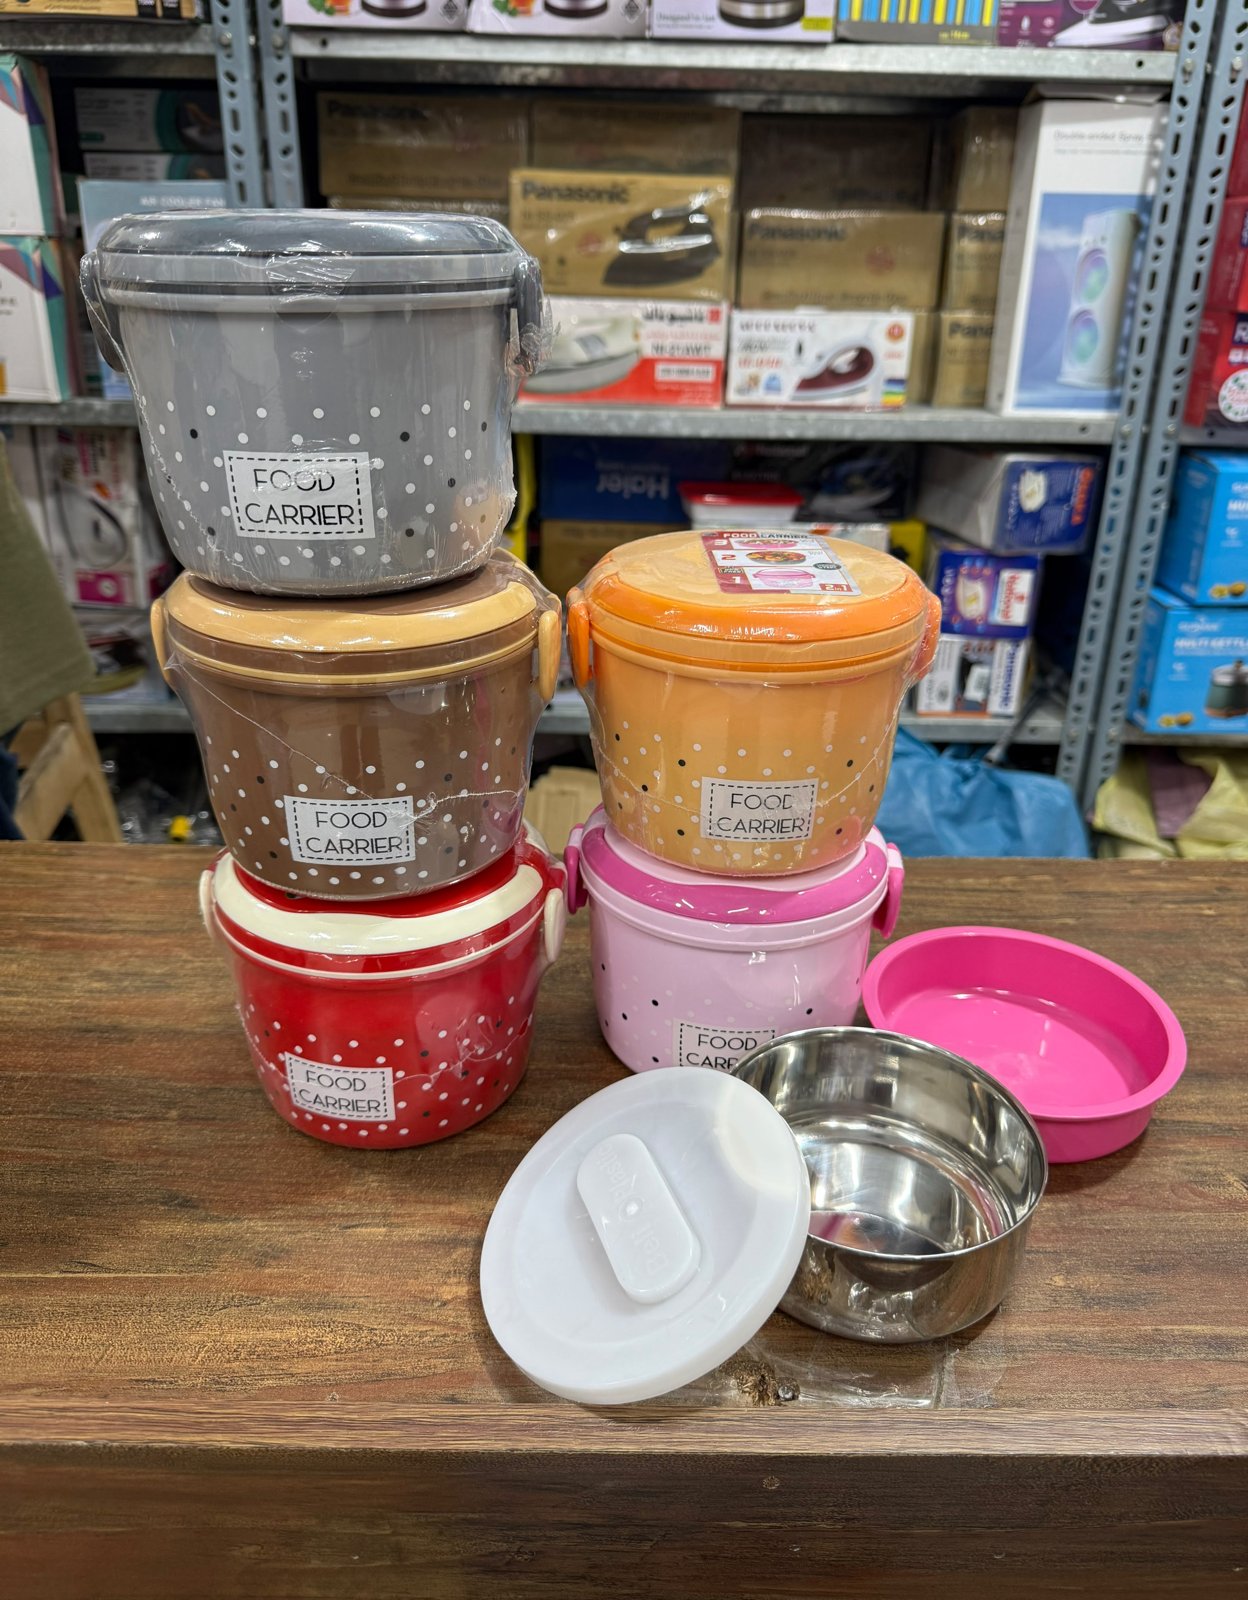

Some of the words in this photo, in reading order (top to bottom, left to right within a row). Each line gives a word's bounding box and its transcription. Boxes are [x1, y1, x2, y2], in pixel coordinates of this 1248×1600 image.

[523, 180, 628, 203] Panasonic
[747, 223, 845, 241] Panasonic
[252, 468, 335, 492] FOOD
[596, 472, 669, 499] Haier
[245, 503, 355, 526] CARRIER
[731, 576, 742, 584] 1
[730, 793, 793, 810] FOOD
[315, 811, 388, 829] FOOD
[717, 817, 806, 834] CARRIER
[306, 836, 403, 855] CARRIER
[697, 1033, 757, 1051] FOOD
[306, 1070, 366, 1092] FOOD
[299, 1088, 381, 1113] CARRIER
